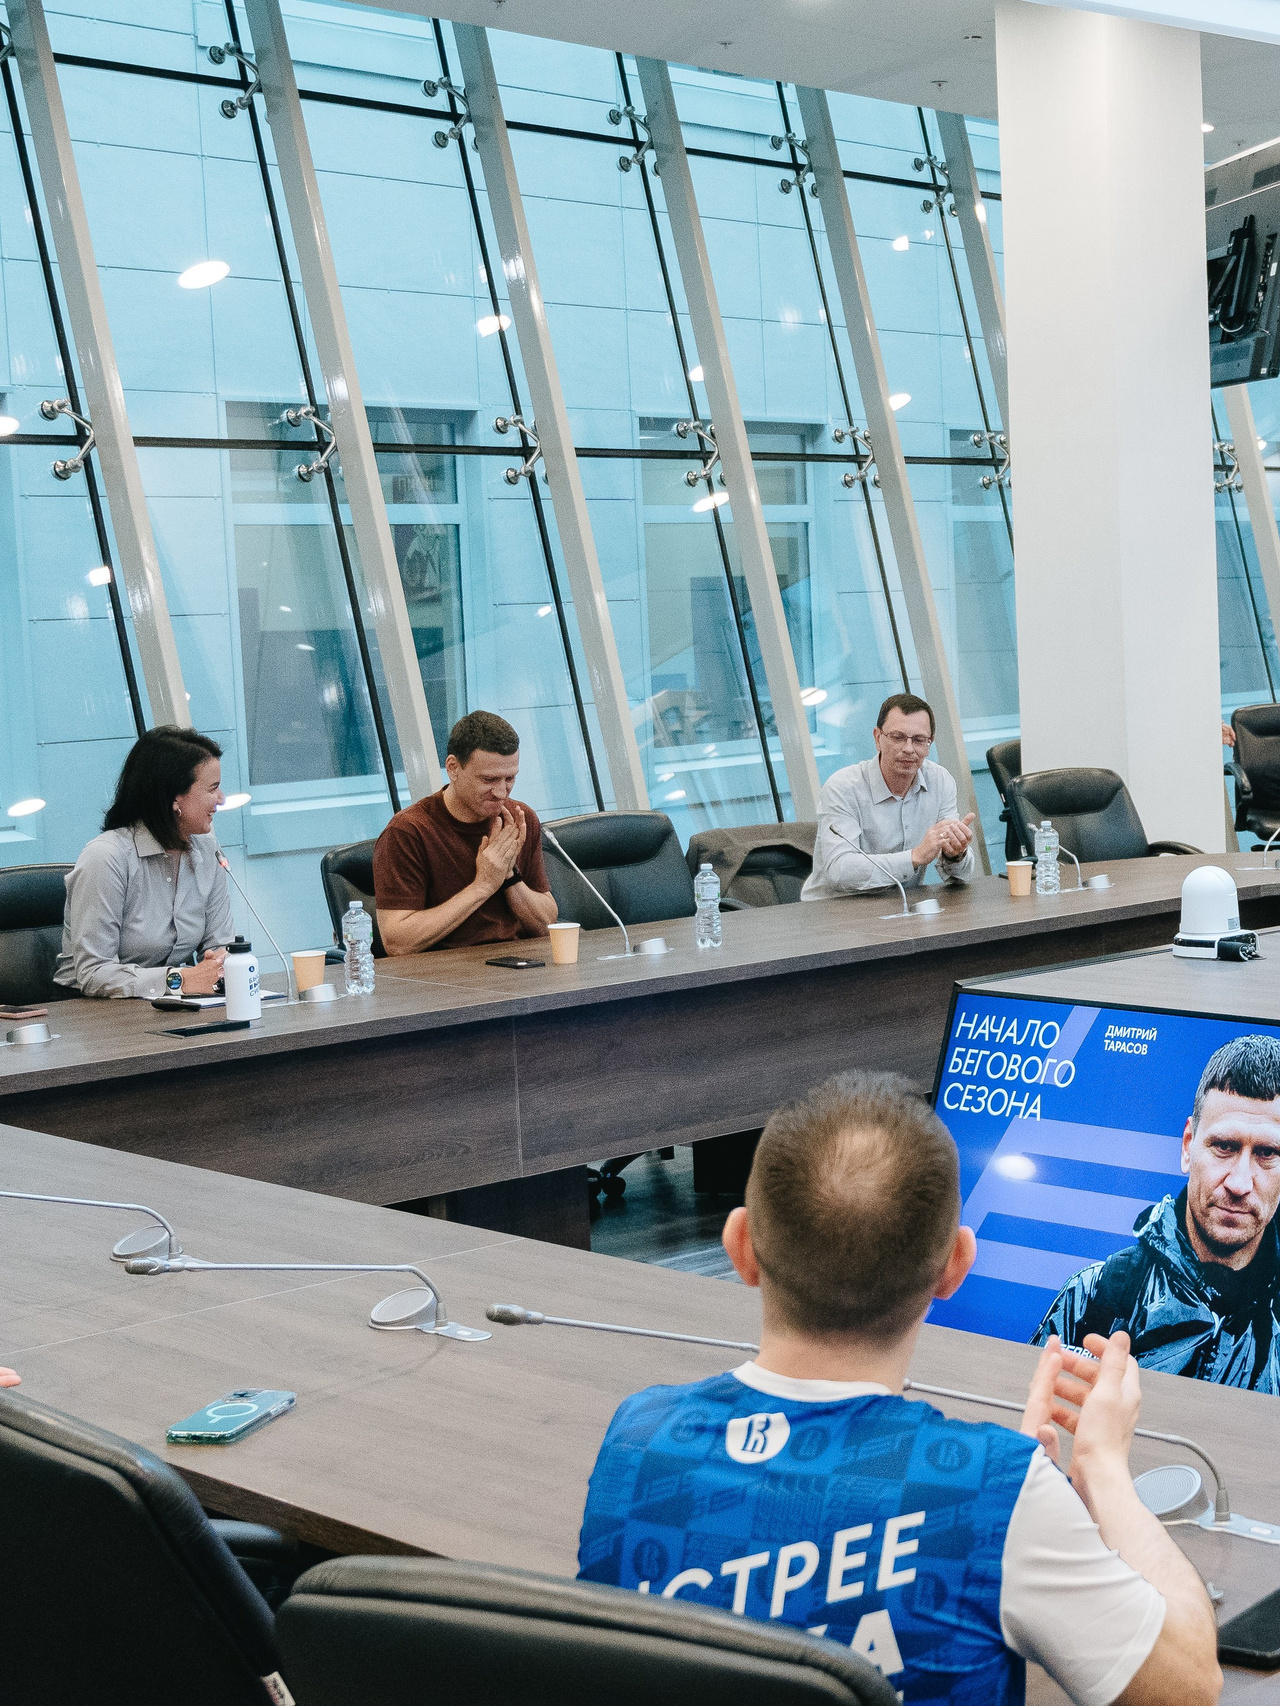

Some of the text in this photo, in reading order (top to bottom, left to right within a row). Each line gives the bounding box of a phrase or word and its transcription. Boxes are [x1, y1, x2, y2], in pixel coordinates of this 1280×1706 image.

[955, 1012, 1061, 1049] НАЧАЛО
[1103, 1040, 1148, 1055] ТАРАСОВ
[1105, 1025, 1158, 1041] ДМИТРИЙ
[948, 1047, 1076, 1088] БЕГОВОГО
[943, 1082, 1041, 1121] СЕЗОНА
[637, 1510, 926, 1619] ТРЕЕ
